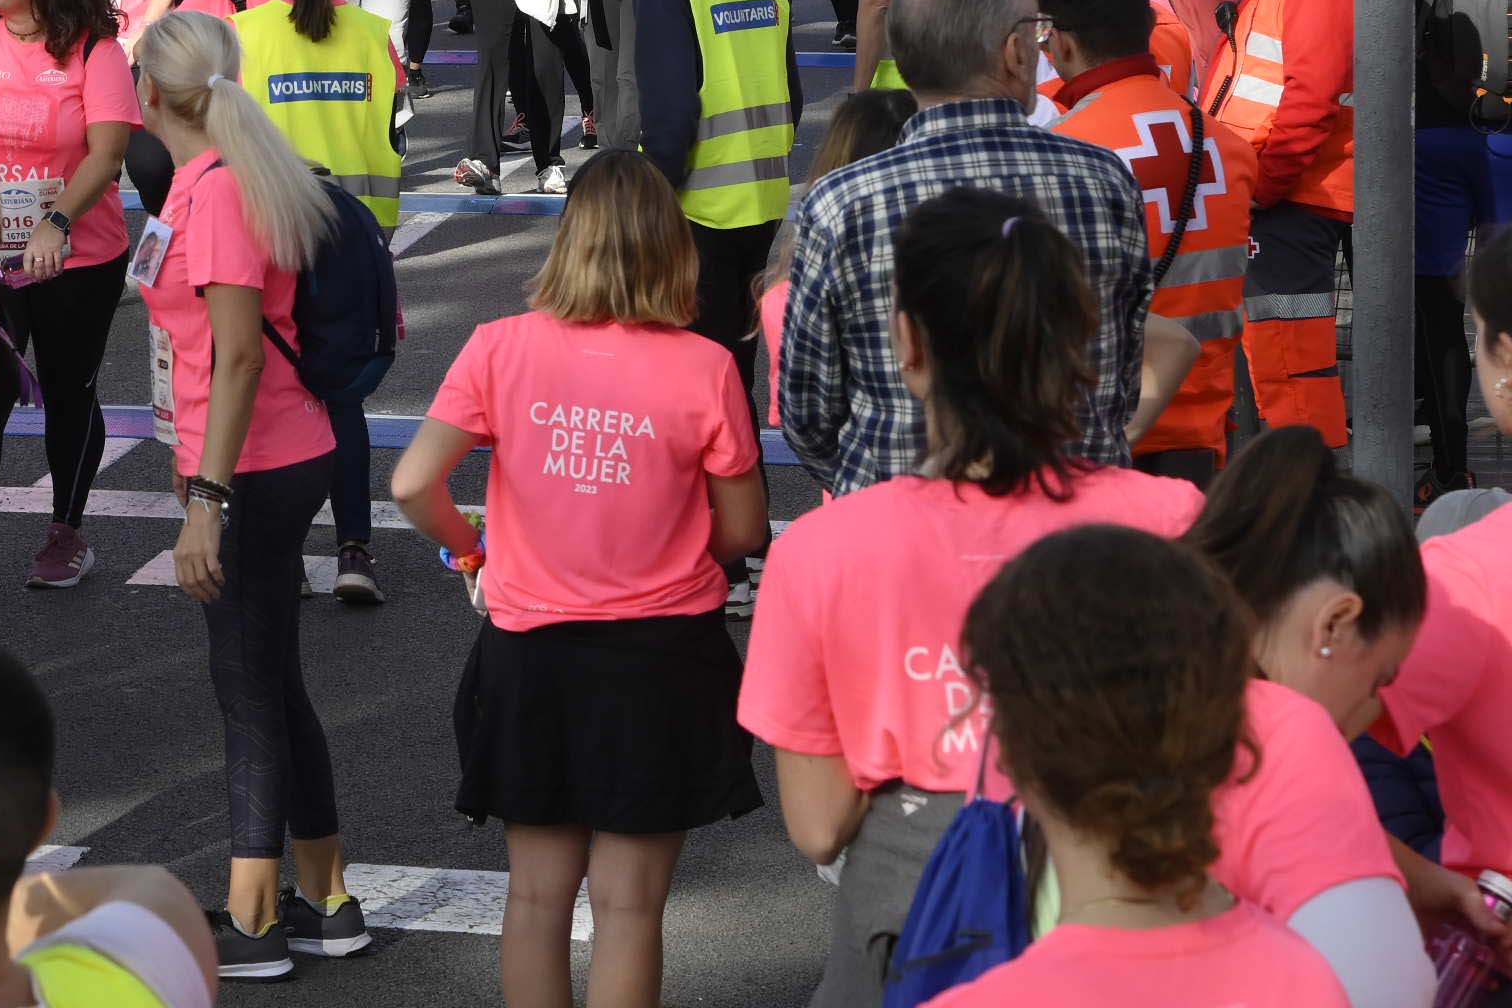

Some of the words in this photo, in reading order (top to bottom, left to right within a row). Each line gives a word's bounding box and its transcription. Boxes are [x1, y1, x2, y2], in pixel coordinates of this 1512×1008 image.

[712, 5, 775, 27] VOLUNTARIS
[270, 79, 365, 97] VOLUNTARIS
[2, 215, 34, 229] 016
[530, 401, 656, 440] CARRERA
[551, 428, 586, 455] DE
[595, 434, 628, 460] LA
[542, 452, 631, 485] MUJER
[574, 483, 598, 495] 2023
